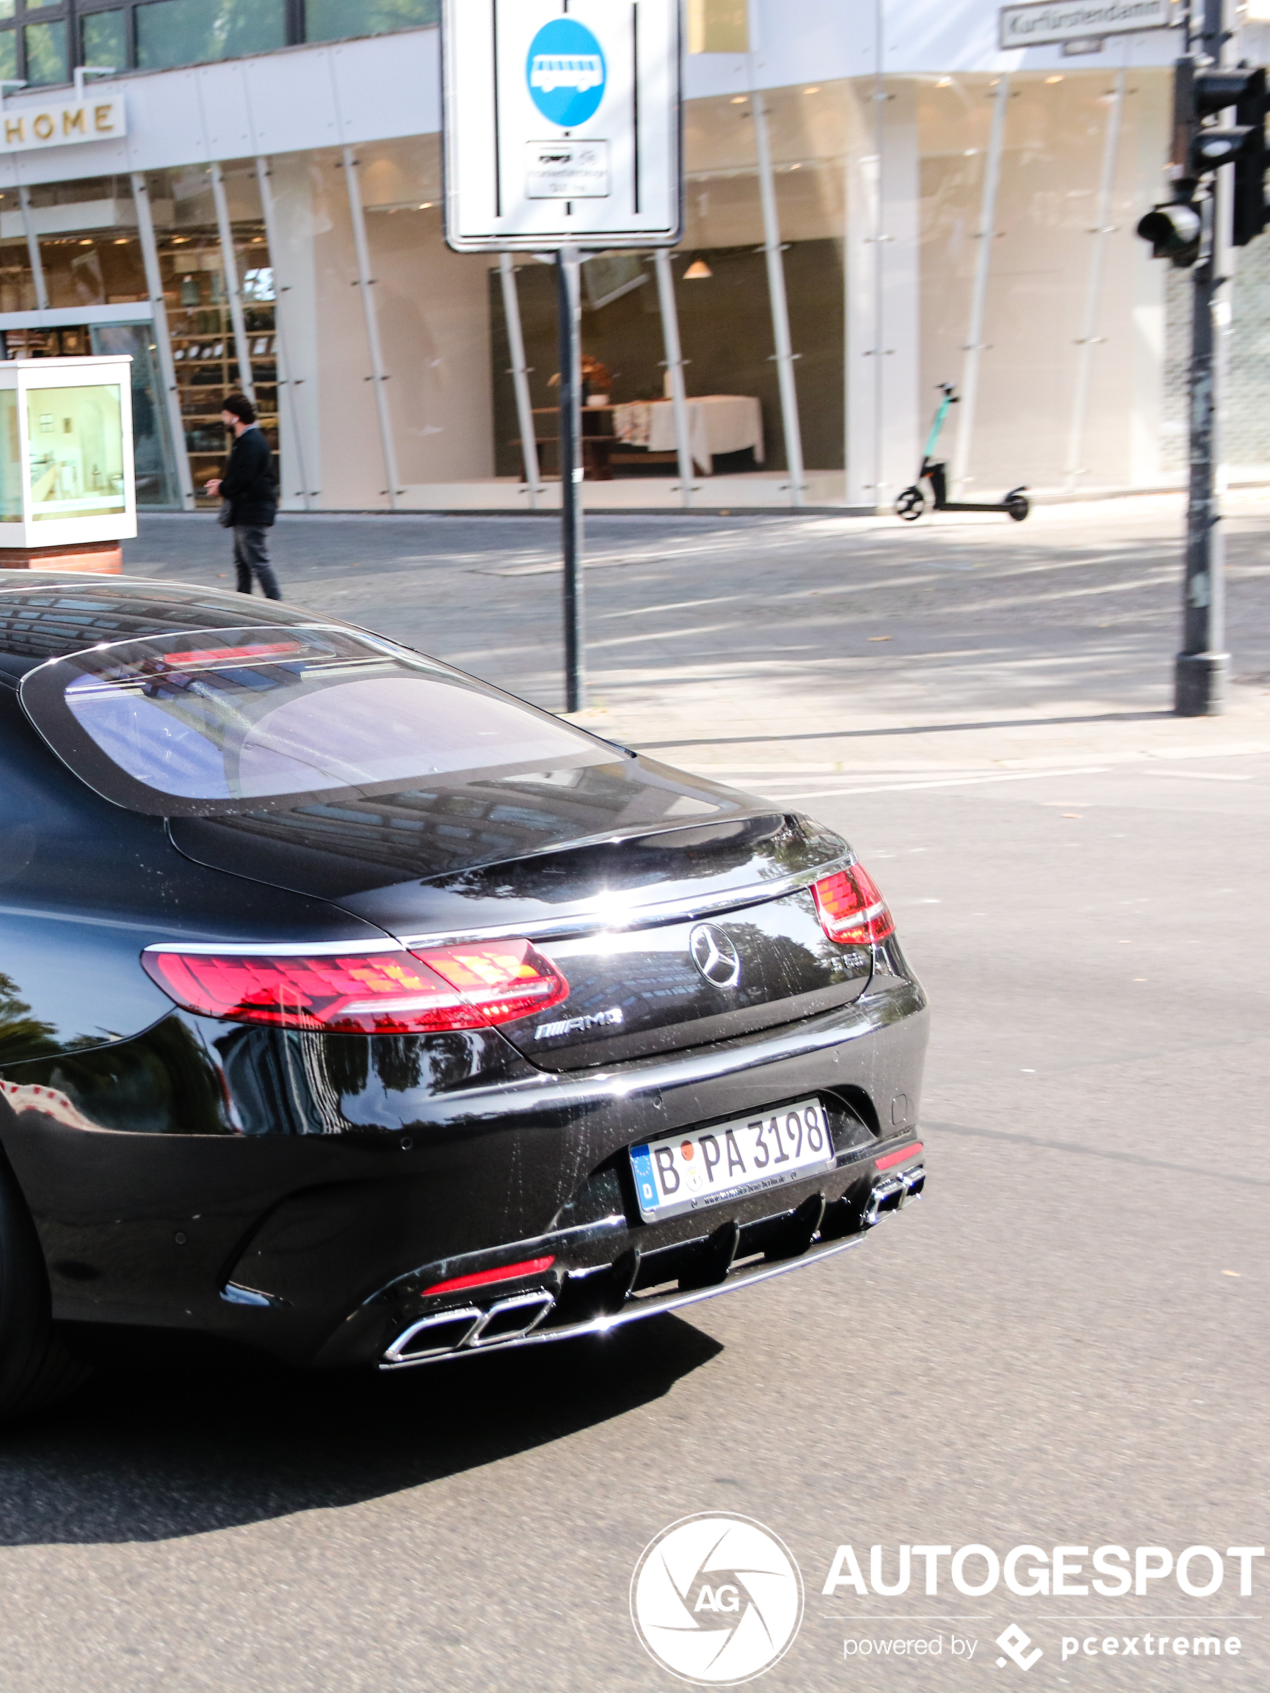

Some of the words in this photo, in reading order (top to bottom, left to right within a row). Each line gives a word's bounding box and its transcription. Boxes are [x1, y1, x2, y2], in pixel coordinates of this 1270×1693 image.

[1009, 0, 1161, 35] Kurfürstendamm
[5, 104, 115, 144] HOME
[548, 1006, 624, 1036] AMG
[654, 1146, 680, 1196] B
[698, 1128, 747, 1183] PA
[747, 1106, 824, 1169] 3198
[643, 1184, 653, 1199] D
